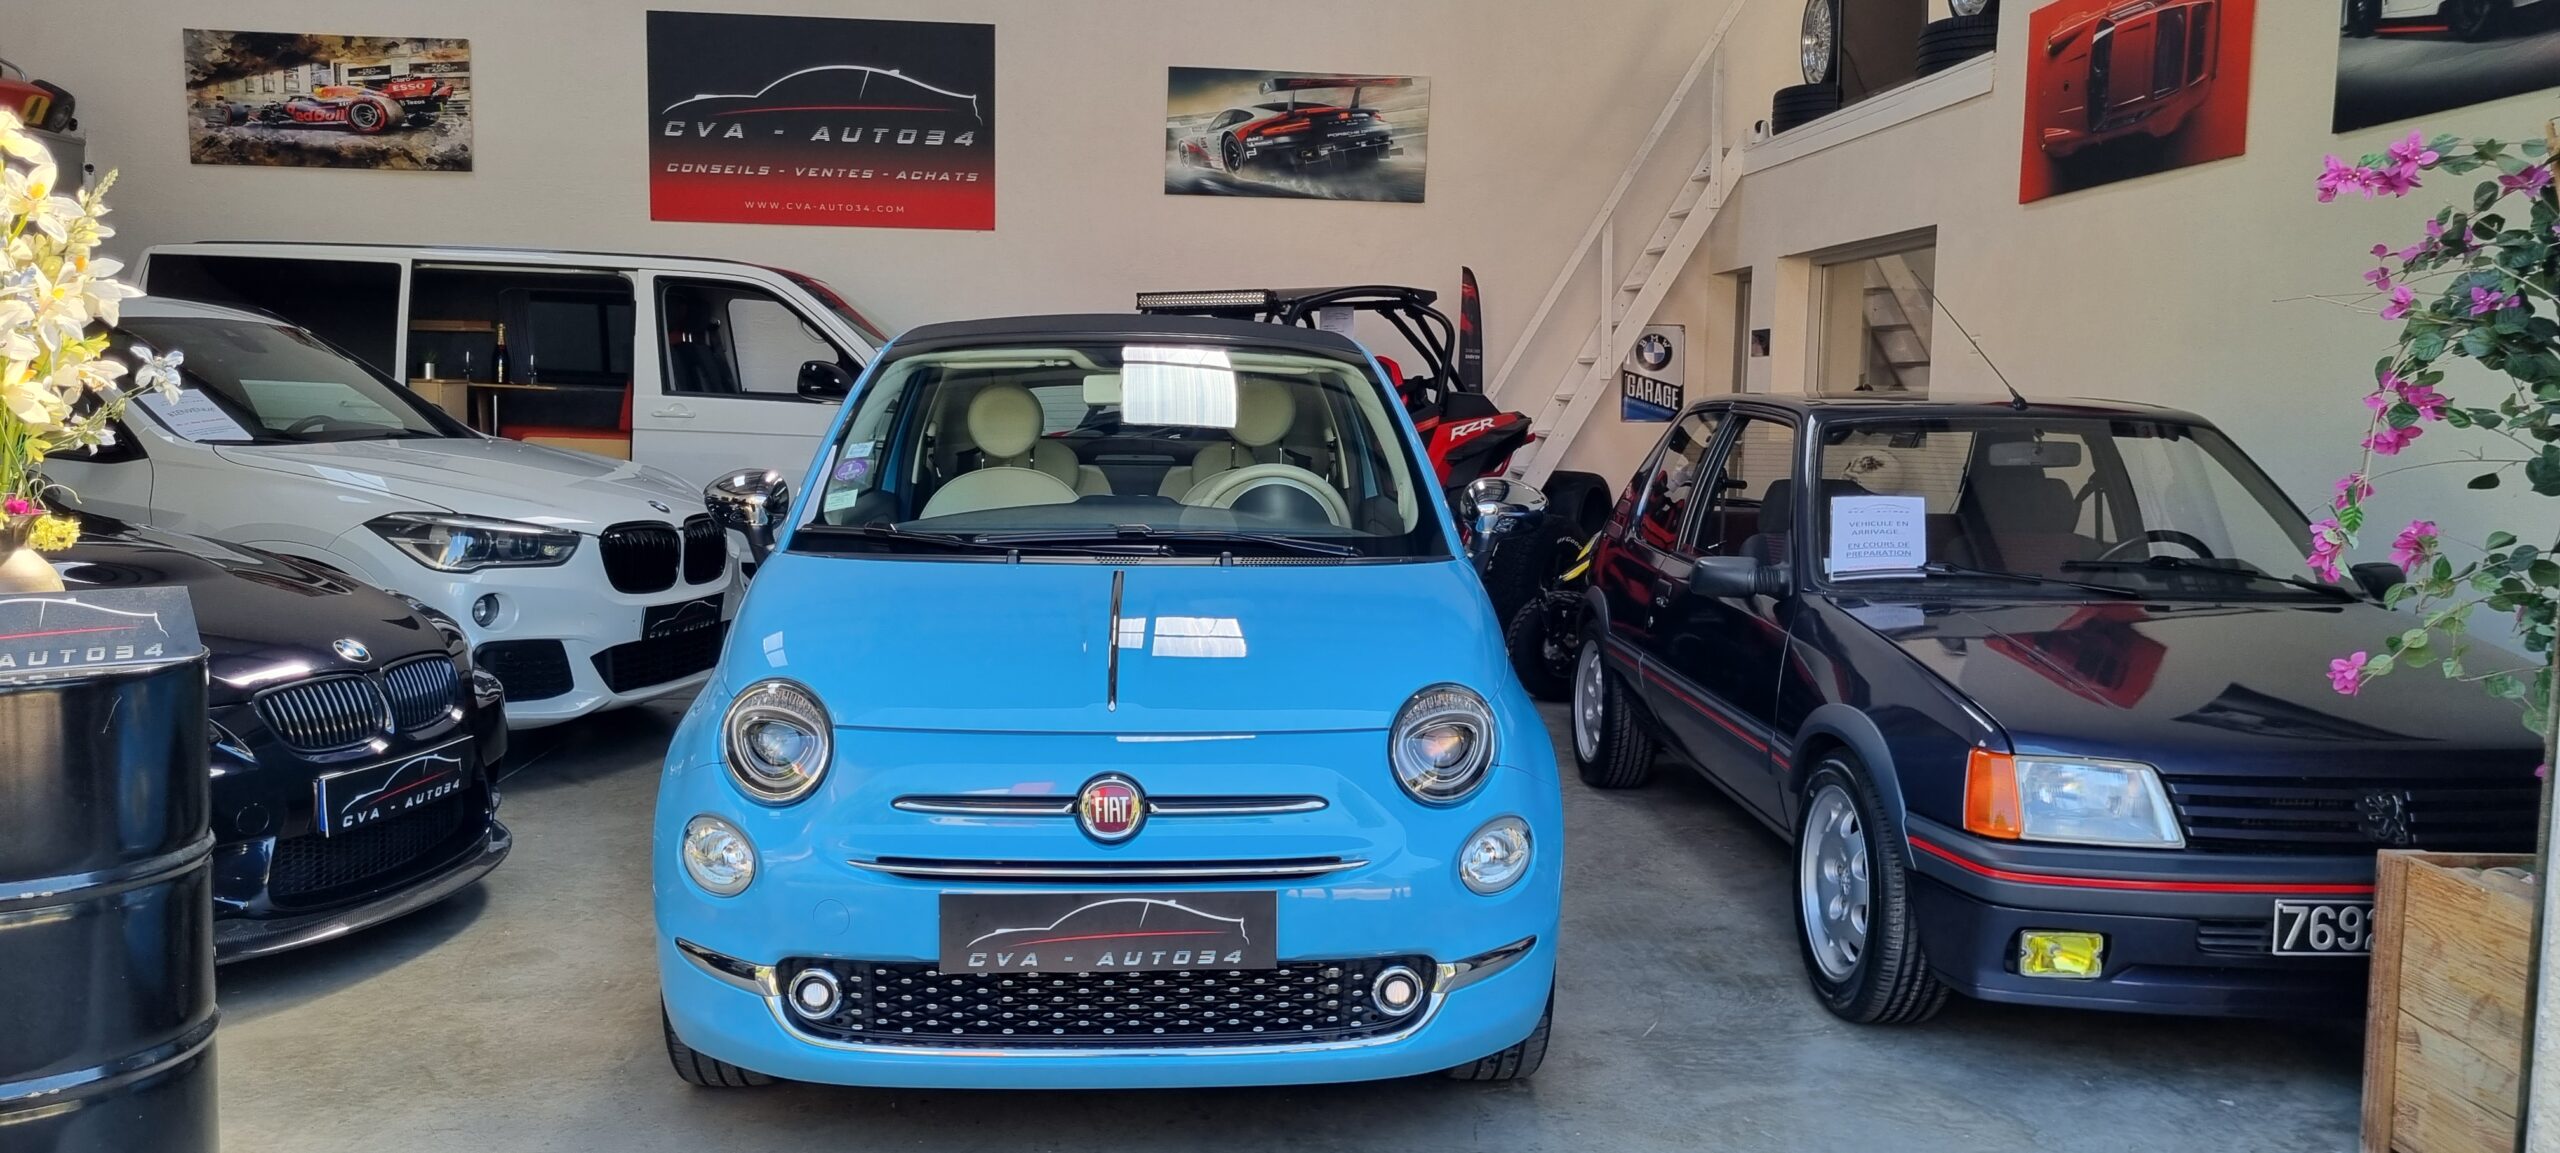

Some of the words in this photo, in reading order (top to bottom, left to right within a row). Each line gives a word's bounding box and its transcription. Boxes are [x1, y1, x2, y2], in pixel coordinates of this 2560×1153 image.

[392, 82, 426, 92] ESSO
[664, 120, 744, 139] CVA
[811, 126, 975, 147] AUTO34
[667, 163, 770, 175] CONSEILS
[795, 167, 874, 179] VENTES
[896, 169, 979, 182] ACHATS
[744, 201, 905, 213] WWW.CVA-AUTO34.COM
[1639, 335, 1671, 348] BMW
[1626, 374, 1679, 410] GARAGE
[1450, 417, 1496, 442] RZR
[0, 643, 163, 667] AUTO34
[343, 808, 380, 828] CVA
[405, 778, 460, 809] AUTO34
[1094, 796, 1129, 823] FIAT
[968, 952, 1038, 967] CVA
[1096, 949, 1242, 966] AUTO34
